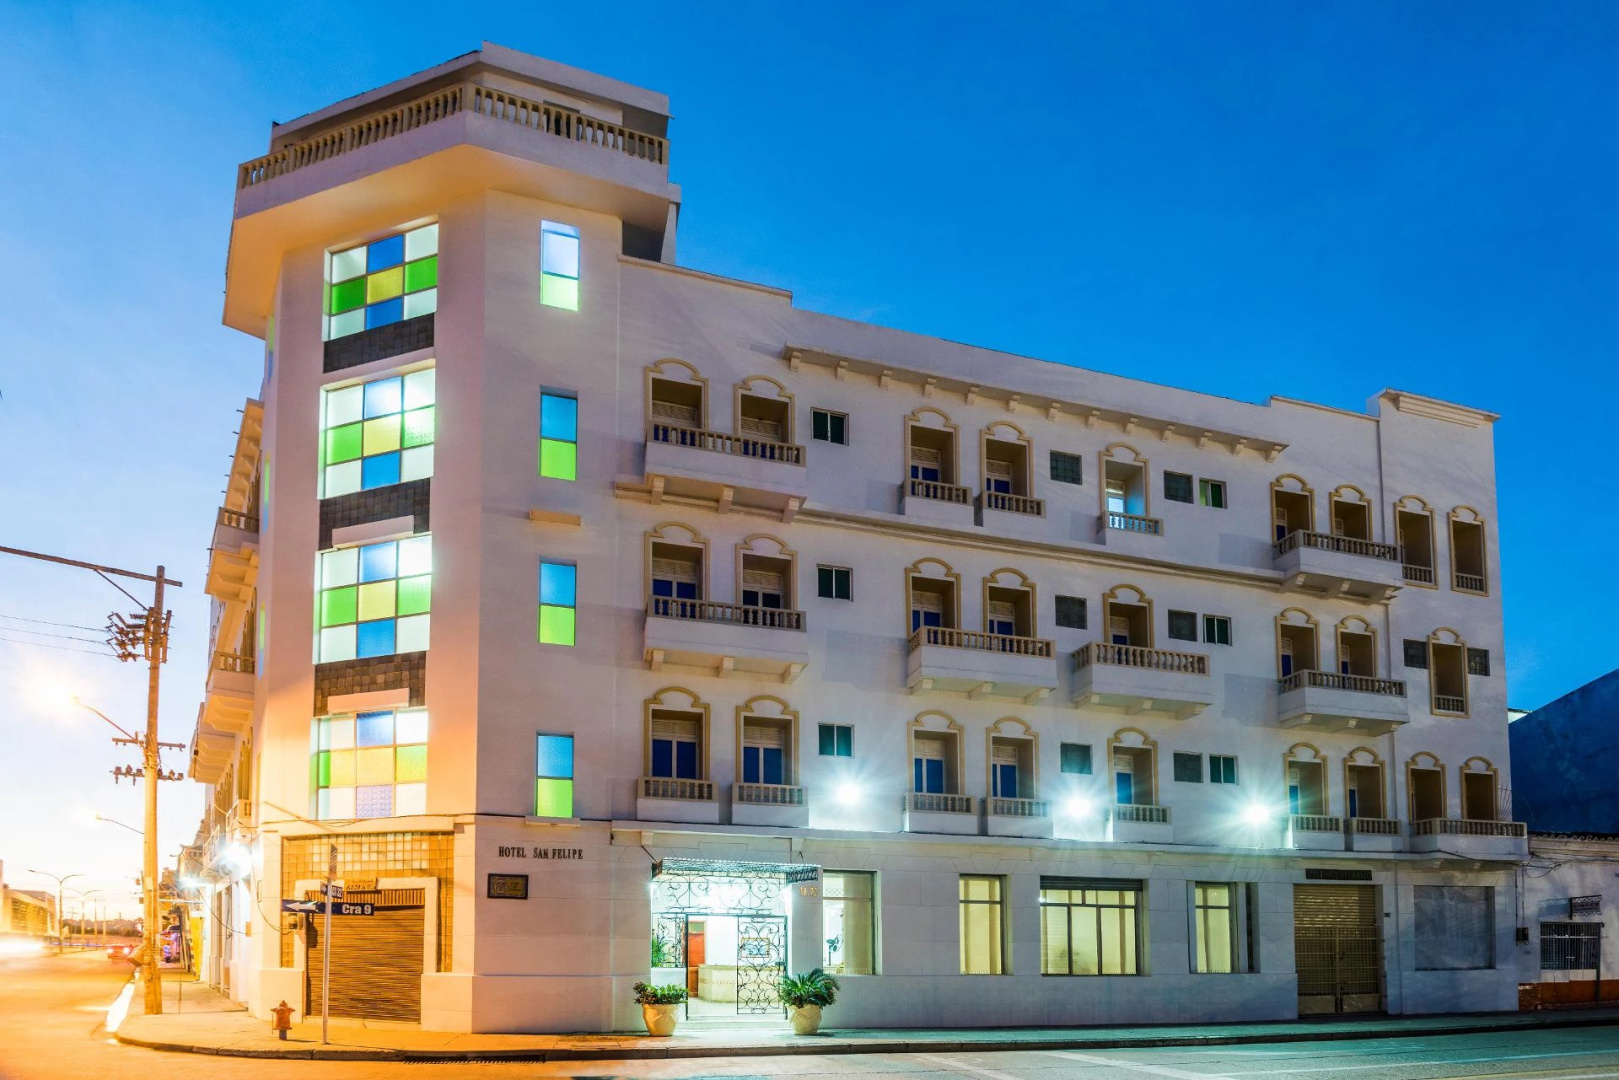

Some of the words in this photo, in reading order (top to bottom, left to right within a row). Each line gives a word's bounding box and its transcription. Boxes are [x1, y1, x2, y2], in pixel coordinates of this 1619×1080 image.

[498, 846, 527, 858] HOTEL
[533, 847, 549, 859] SAN
[552, 848, 584, 860] FELIPE
[342, 904, 362, 914] Cra
[364, 904, 372, 915] 9
